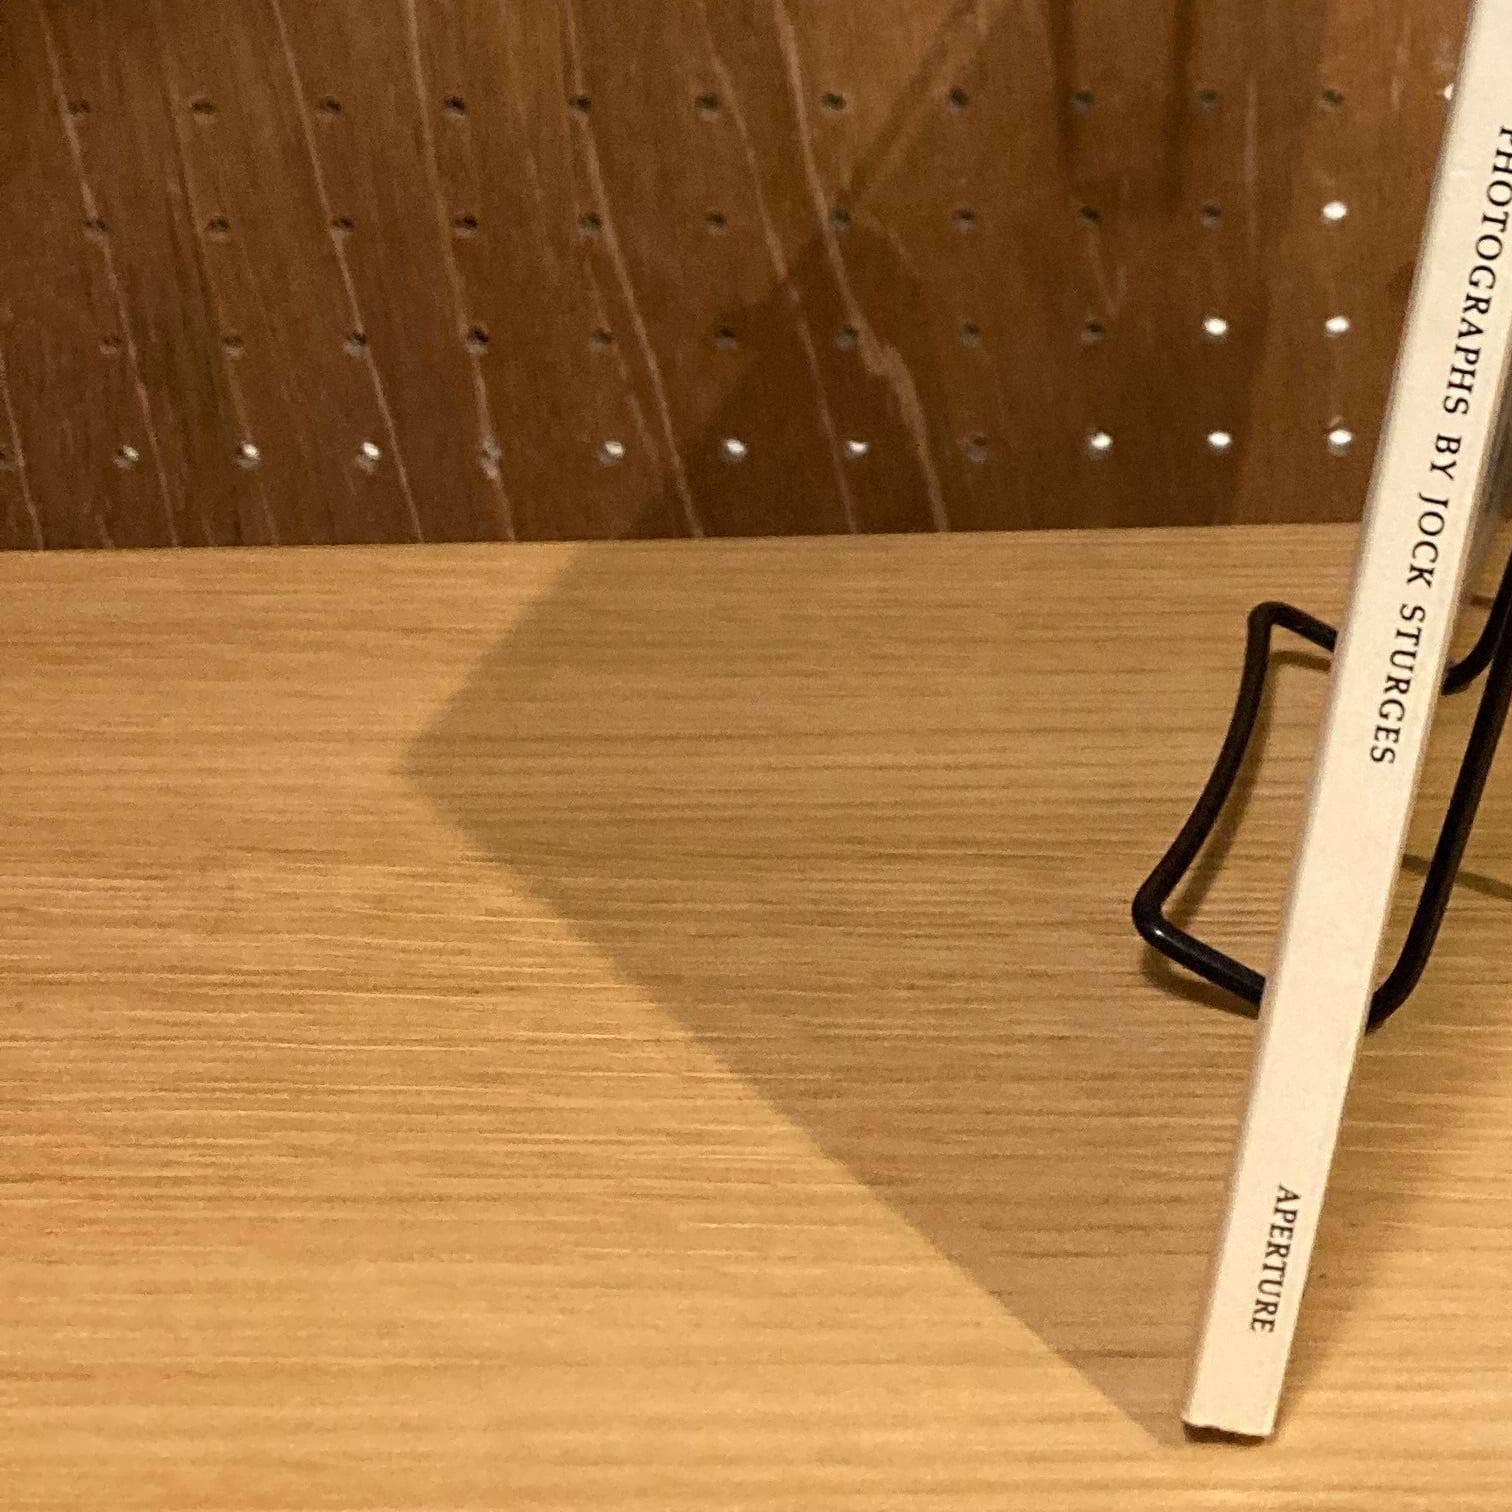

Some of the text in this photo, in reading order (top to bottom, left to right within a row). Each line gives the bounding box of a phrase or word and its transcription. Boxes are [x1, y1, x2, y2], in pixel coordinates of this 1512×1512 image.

[1428, 432, 1464, 483] BY
[1404, 490, 1451, 590] JOCK
[1368, 601, 1428, 766] STURGES
[1248, 1183, 1302, 1334] APERTURE
